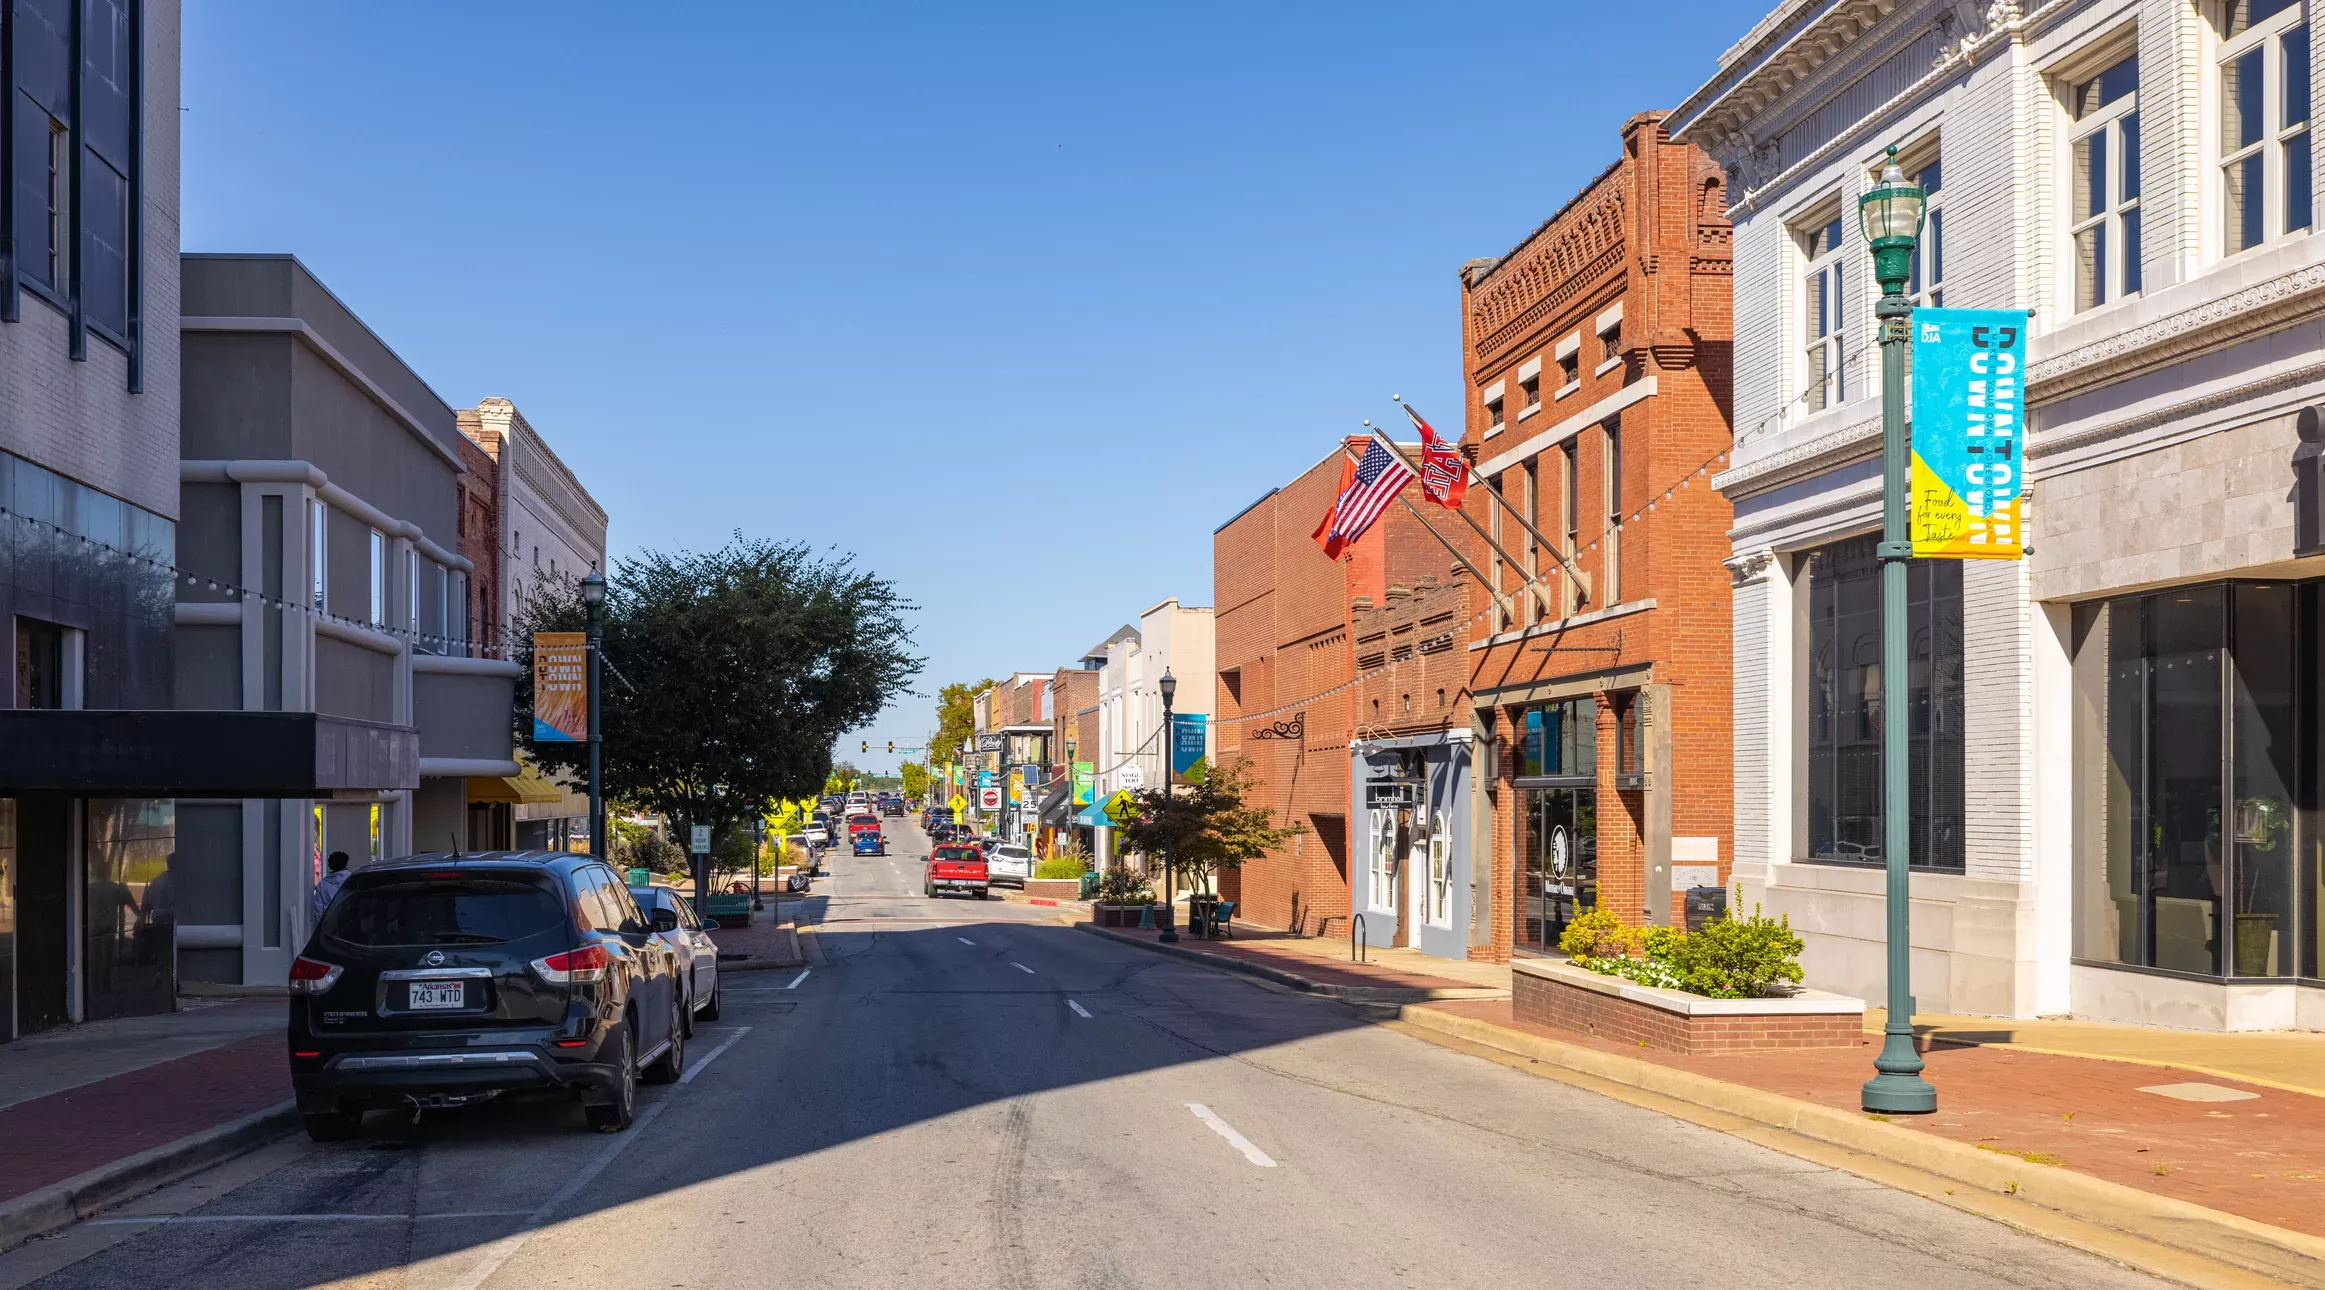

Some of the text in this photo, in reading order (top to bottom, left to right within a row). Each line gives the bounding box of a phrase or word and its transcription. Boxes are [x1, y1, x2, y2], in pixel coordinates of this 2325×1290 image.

[1921, 332, 1941, 343] DJA
[1990, 333, 1998, 360] MAKE
[1989, 365, 1996, 375] IT
[1986, 380, 1995, 408] YOUR
[1925, 486, 1955, 510] Food
[1917, 505, 1961, 530] for every
[1922, 523, 1955, 543] Taste
[1022, 800, 1037, 808] 25
[698, 828, 703, 836] 2
[422, 983, 453, 991] Arkansas
[411, 989, 461, 1004] 743 WTD
